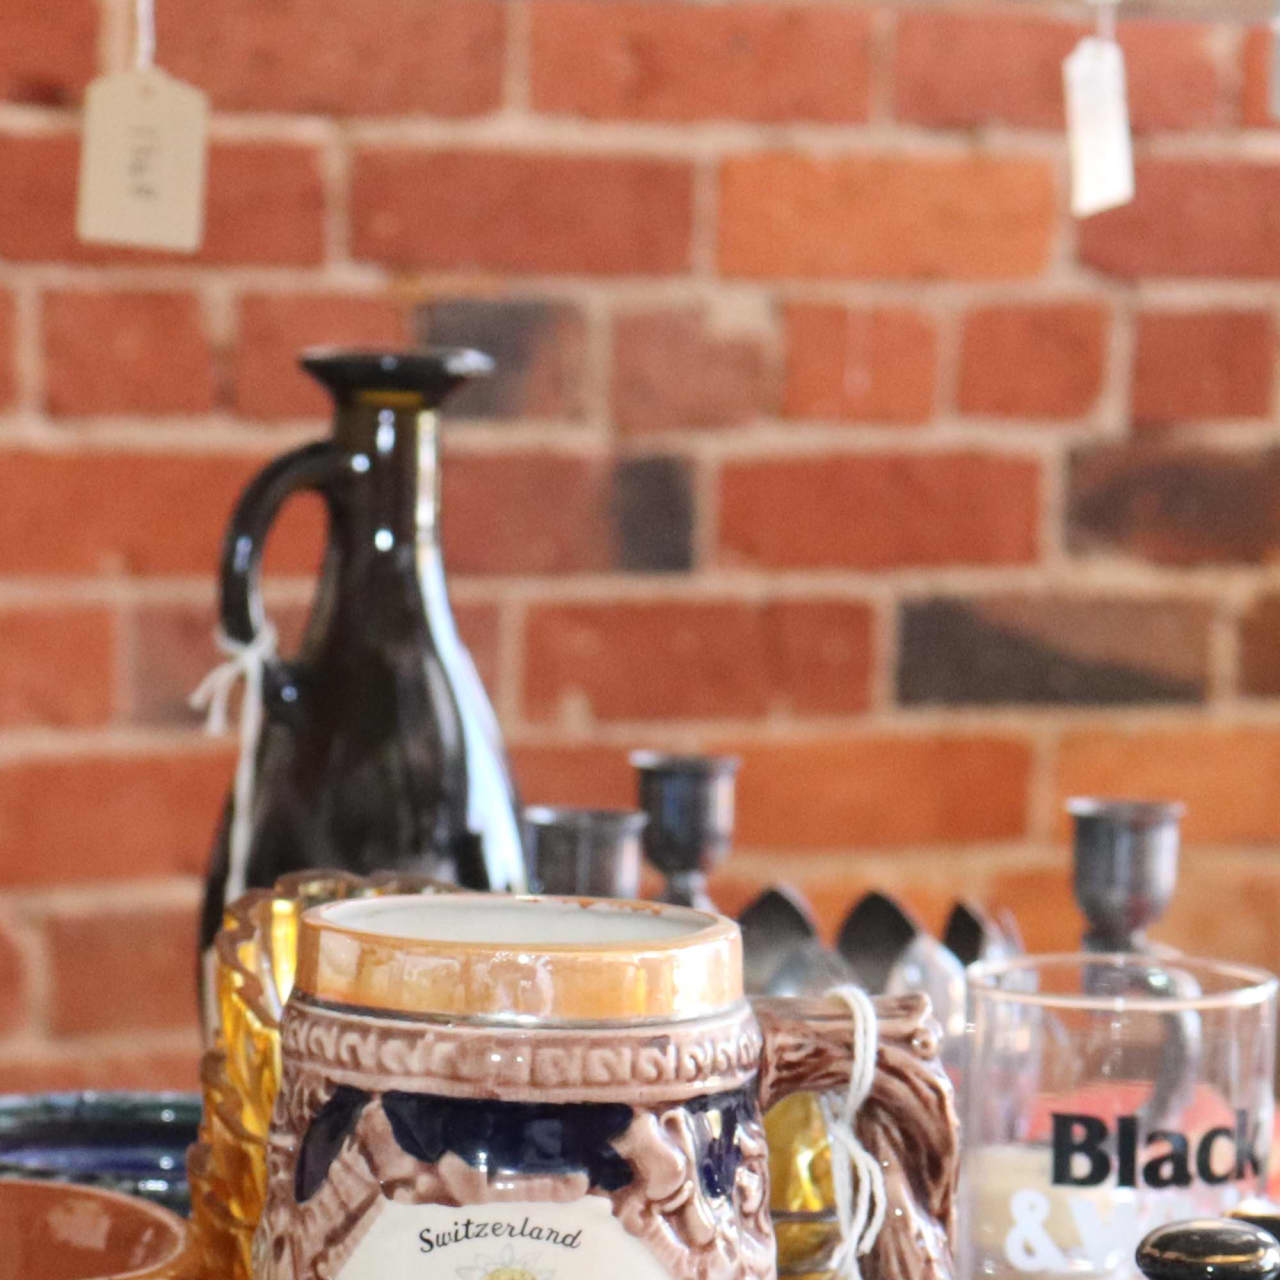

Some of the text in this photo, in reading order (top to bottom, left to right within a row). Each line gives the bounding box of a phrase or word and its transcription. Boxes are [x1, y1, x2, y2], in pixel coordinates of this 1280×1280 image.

[1051, 1109, 1260, 1188] Black
[419, 1217, 583, 1253] Switzerland
[1006, 1188, 1069, 1274] &
